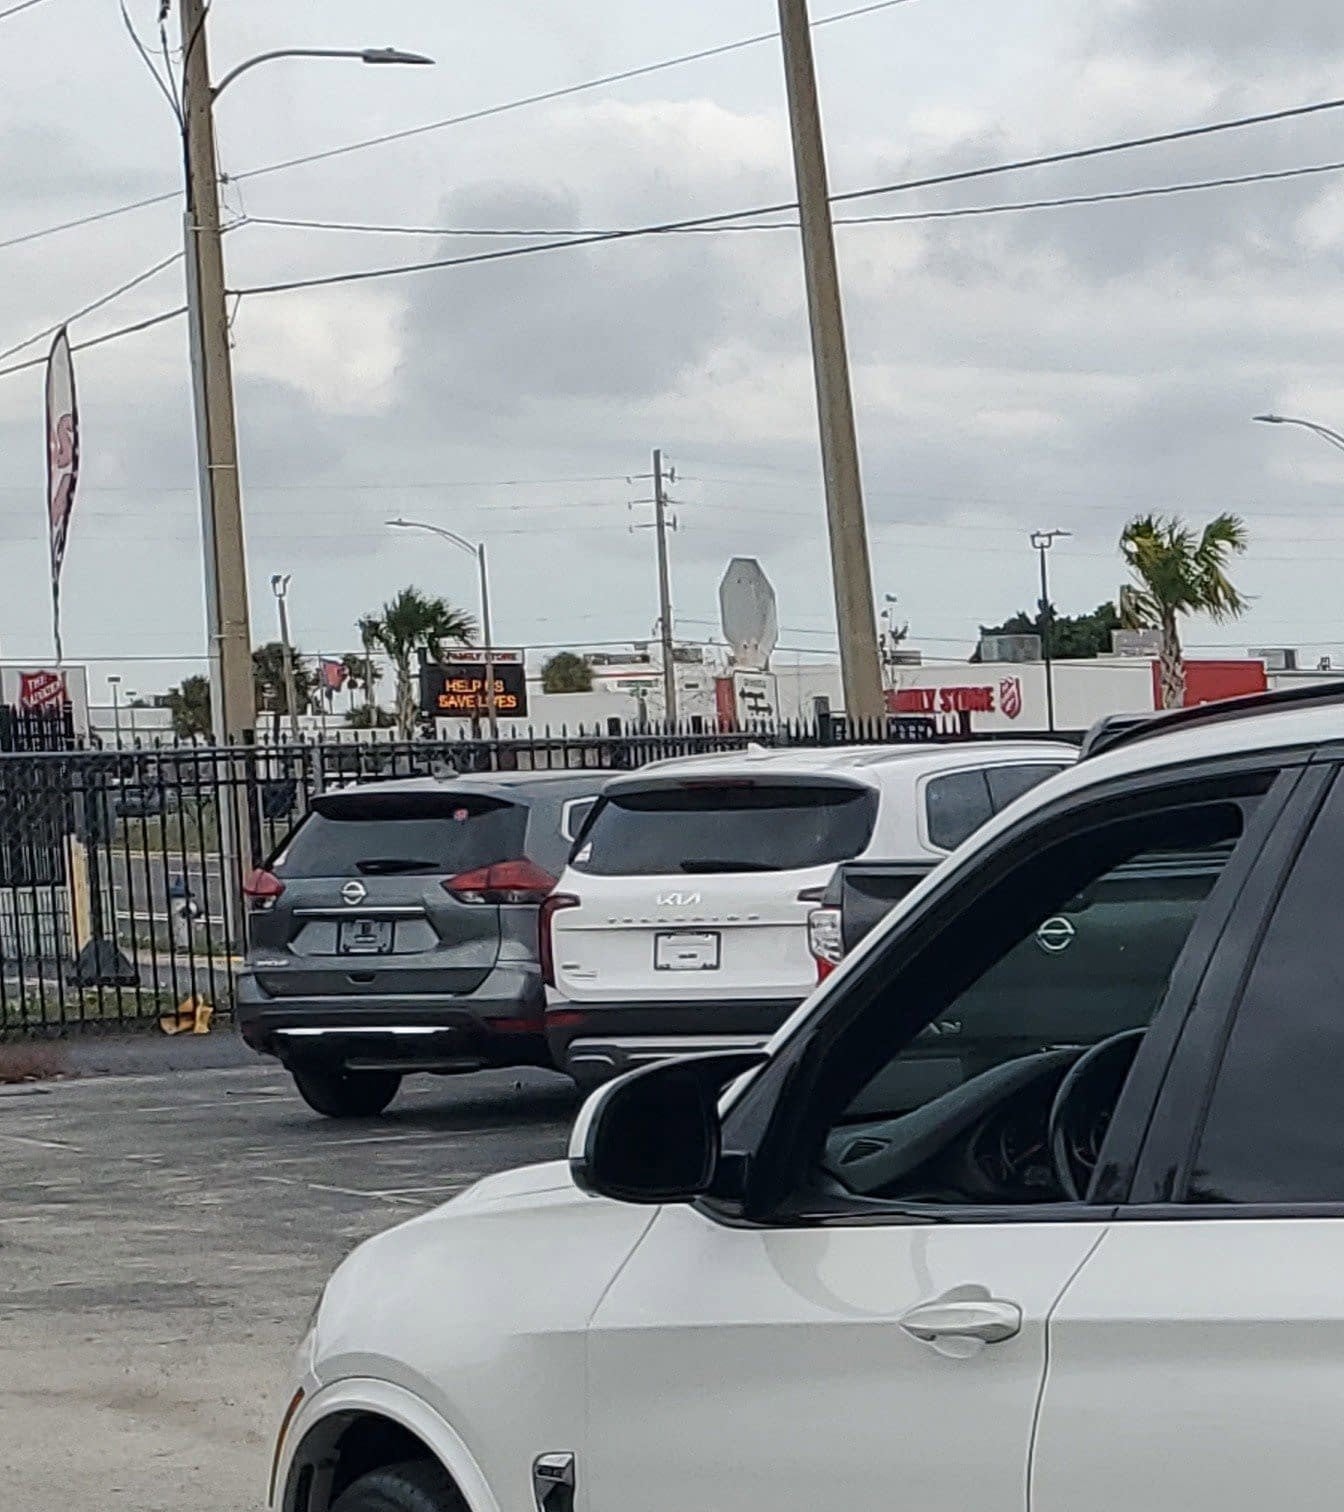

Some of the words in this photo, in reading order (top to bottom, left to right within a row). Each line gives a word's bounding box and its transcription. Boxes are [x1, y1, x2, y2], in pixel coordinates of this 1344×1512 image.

[445, 679, 481, 693] HELP
[439, 694, 476, 708] SAVE
[477, 694, 517, 708] LVES
